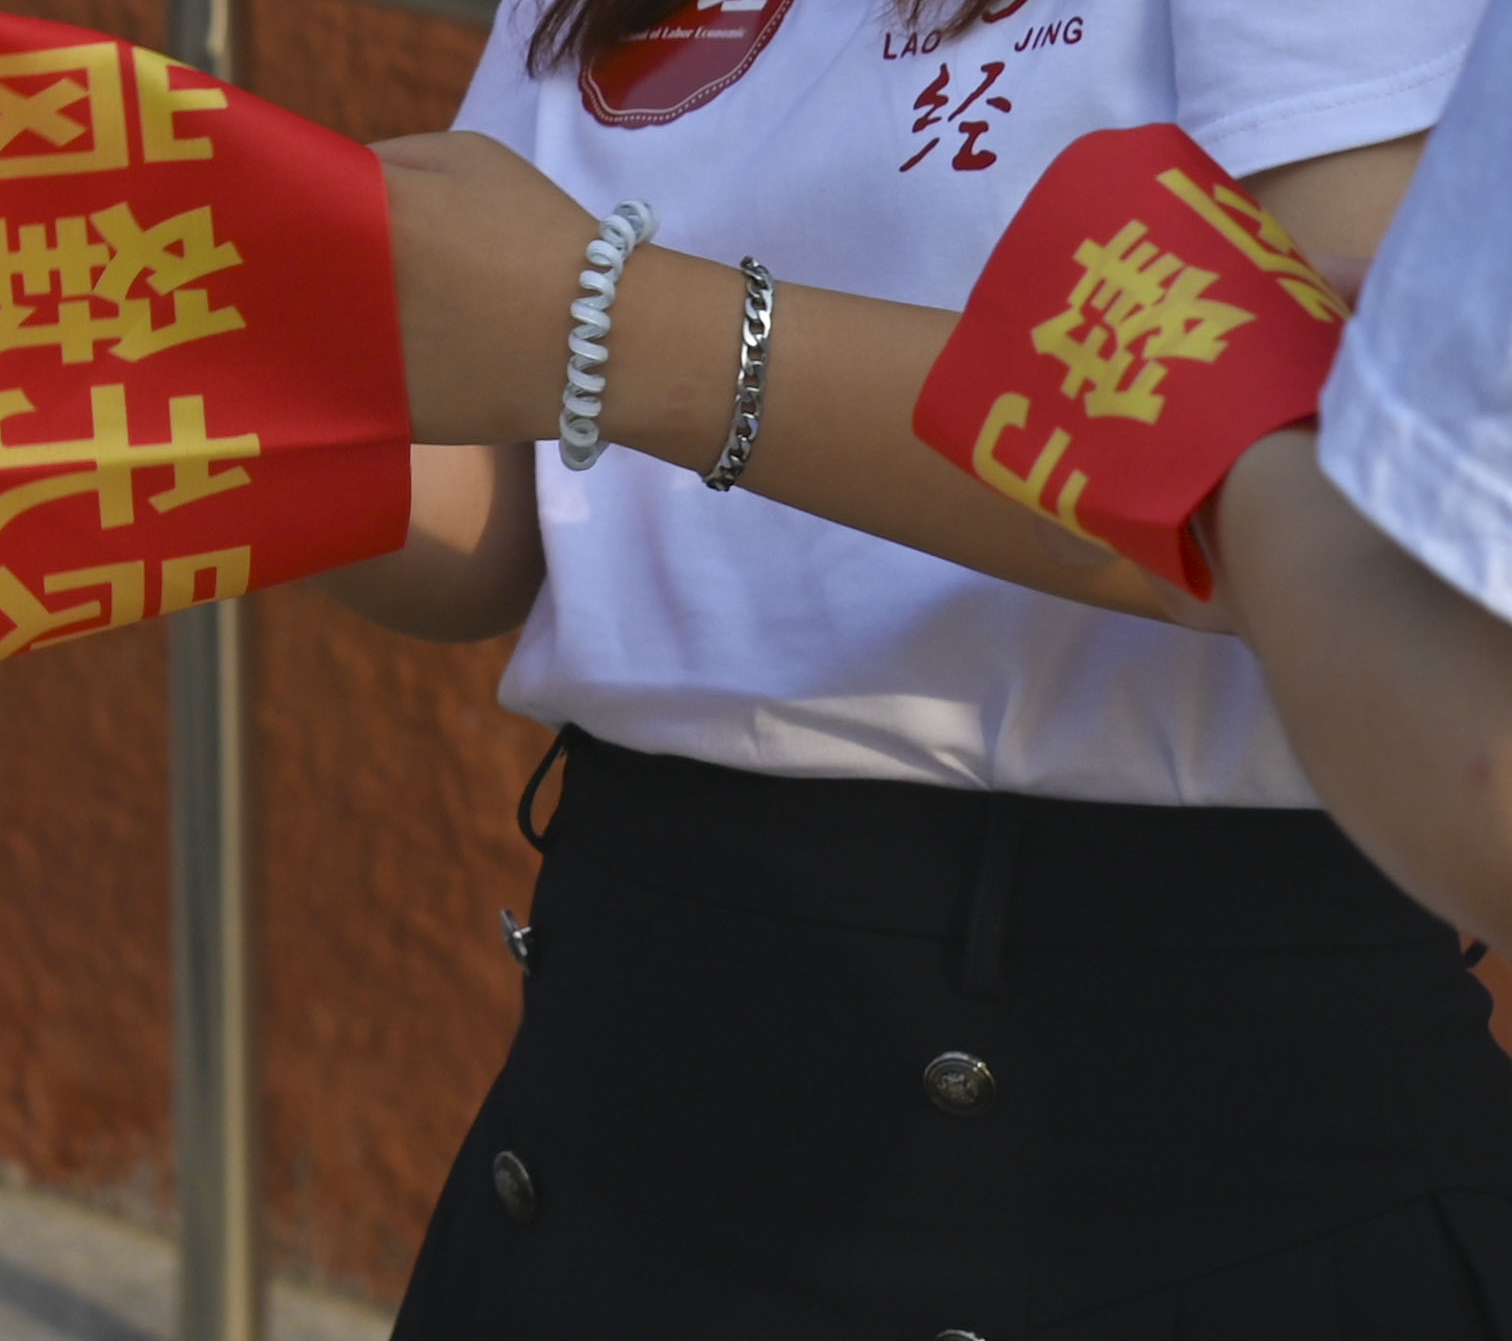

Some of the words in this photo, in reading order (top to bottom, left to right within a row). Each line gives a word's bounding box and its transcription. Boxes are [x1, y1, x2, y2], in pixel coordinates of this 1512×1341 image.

[882, 30, 941, 60] LAO
[1014, 16, 1084, 53] JING
[898, 61, 1012, 173] 经
